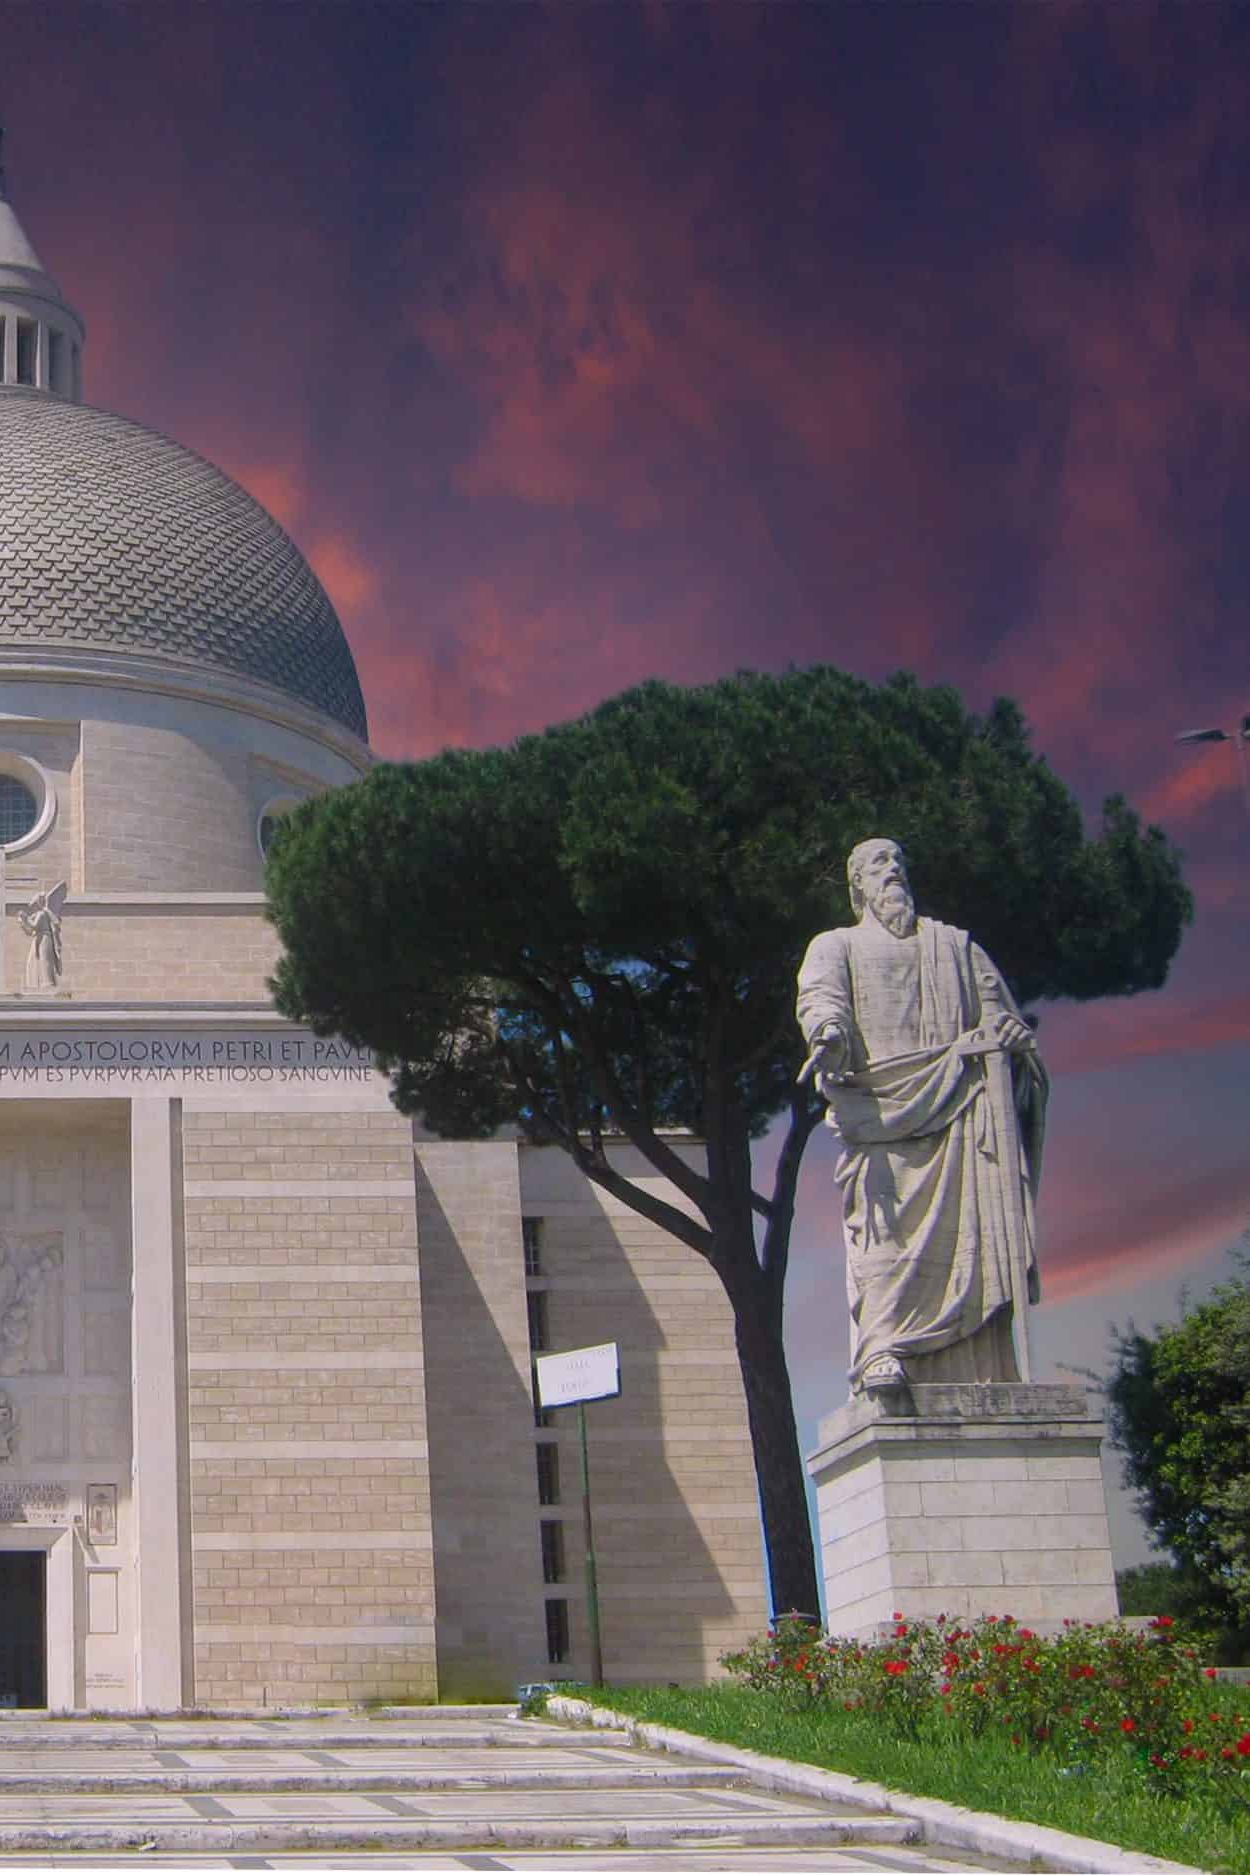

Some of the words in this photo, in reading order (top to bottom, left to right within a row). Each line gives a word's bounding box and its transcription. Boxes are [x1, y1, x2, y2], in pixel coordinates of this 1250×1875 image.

[20, 1040, 201, 1062] APOSTOLORVM
[213, 1040, 272, 1062] PETRI
[281, 1040, 306, 1062] ET
[46, 1065, 64, 1082] ES
[70, 1065, 176, 1082] PVRPVRATA
[182, 1065, 274, 1082] PRETIOSO
[279, 1065, 373, 1082] SANGVINE
